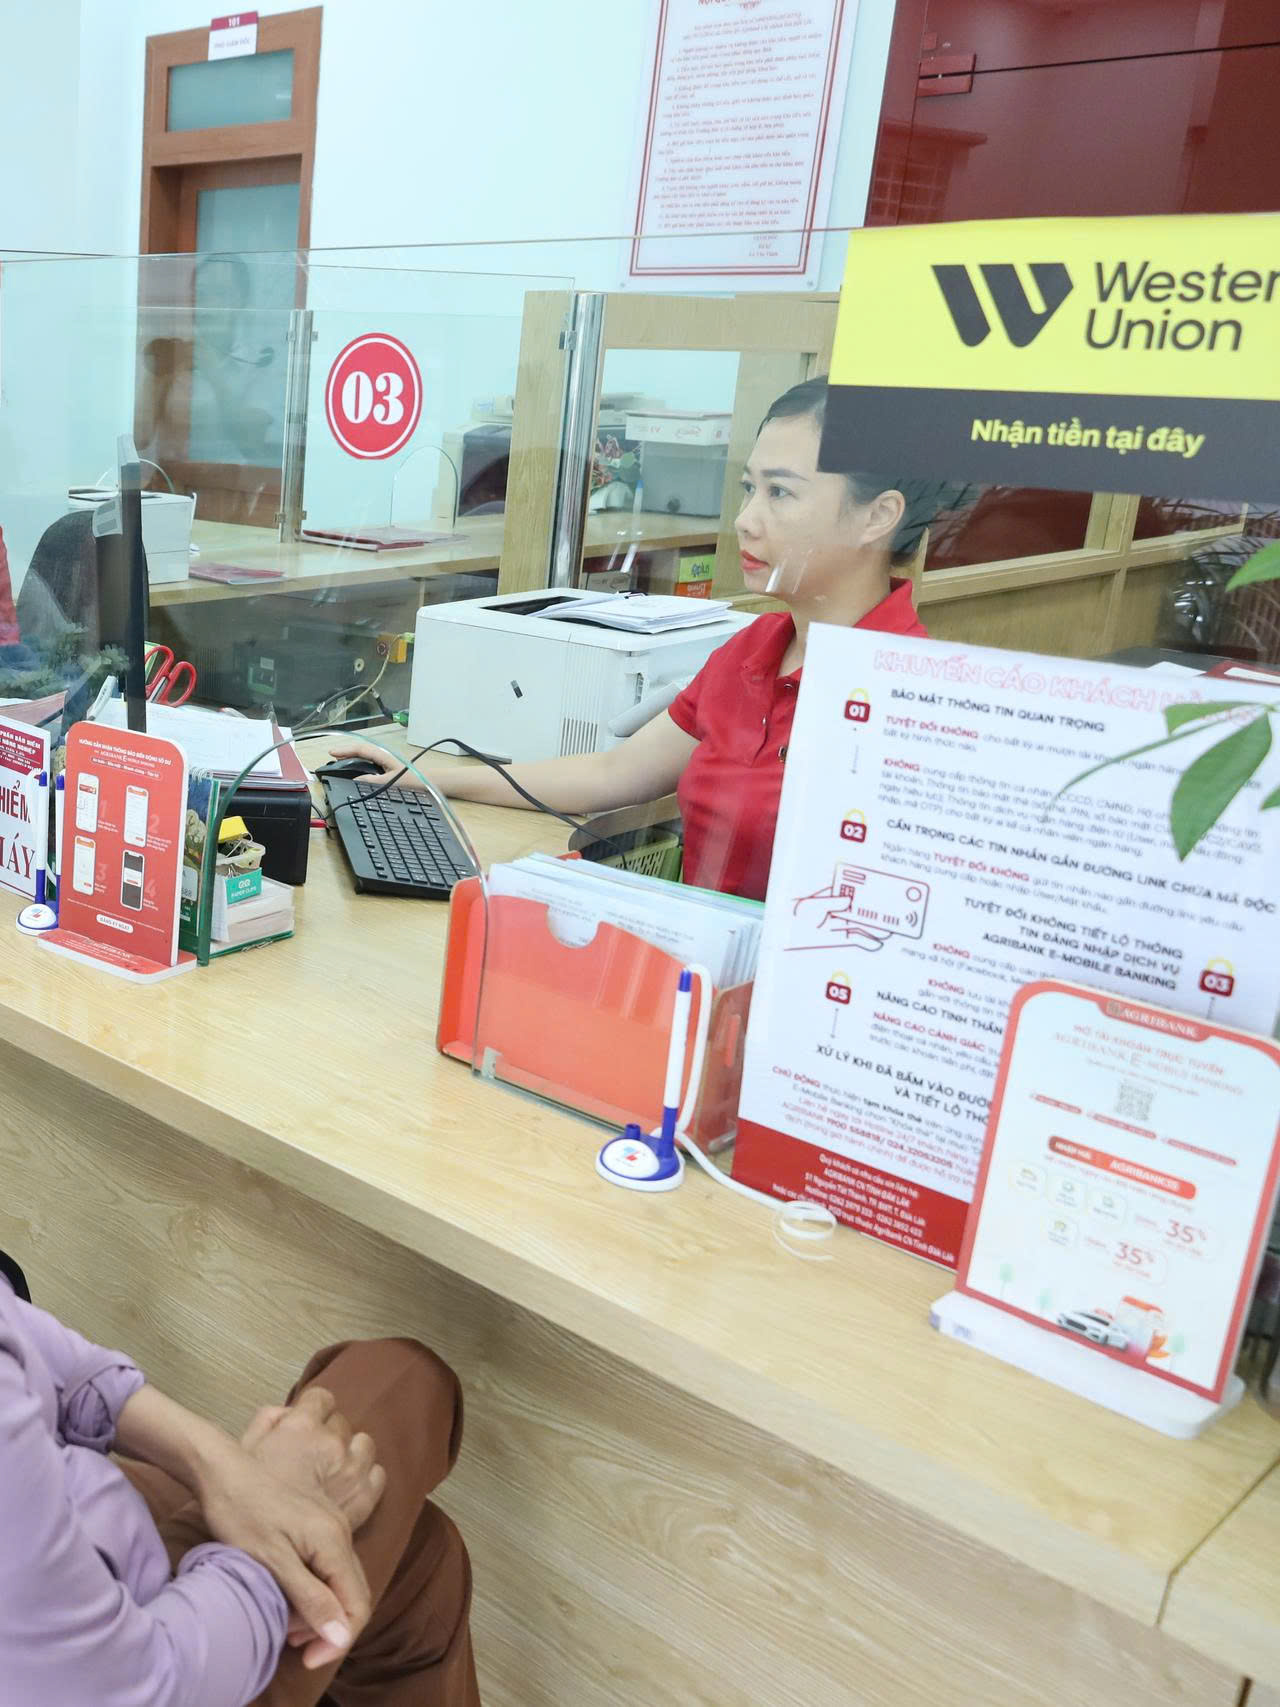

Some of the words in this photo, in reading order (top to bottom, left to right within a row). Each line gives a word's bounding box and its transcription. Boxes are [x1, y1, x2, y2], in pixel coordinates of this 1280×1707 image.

[1095, 260, 1280, 303] Wester
[1085, 307, 1243, 351] Union
[342, 371, 404, 426] 03
[971, 419, 1042, 449] Nhận
[1047, 417, 1100, 447] tiền
[1105, 425, 1144, 455] tại
[1147, 426, 1205, 459] đây
[873, 649, 983, 684] KHUYẾN
[984, 664, 1046, 694] CÁO
[1048, 673, 1158, 713] KHÁCH
[848, 703, 866, 719] 01
[891, 688, 916, 702] BẢO
[948, 697, 990, 714] THÔNG
[994, 706, 1014, 718] TIN
[1017, 709, 1055, 724] QUAN
[1058, 716, 1105, 734] TRỌNG
[843, 823, 864, 839] 02
[915, 825, 955, 843] TRỌNG
[958, 833, 984, 848] CÁC
[989, 841, 1007, 854] TIN
[1083, 861, 1133, 882] ĐƯỜNG
[1137, 874, 1167, 889] LINK
[1171, 881, 1212, 900] CHỨA
[1216, 890, 1239, 905] MÃ
[1243, 897, 1277, 914] ĐỘC
[964, 897, 1002, 915] TUYỆT
[1005, 906, 1028, 921] ĐỐI
[1030, 913, 1077, 934] KHÔNG
[1081, 924, 1107, 940] TIẾT
[1111, 933, 1130, 948] LỘ
[1134, 939, 1183, 960] THÔNG
[982, 931, 1045, 956] AGRIBANK
[1049, 949, 1112, 976] E-MOBILE
[1115, 966, 1177, 991] BANKING
[1019, 925, 1039, 939] TIN
[1123, 952, 1158, 970] DỊCH
[1161, 962, 1181, 976] VỤ
[828, 984, 850, 1000] 05
[876, 990, 909, 1008] NÂNG
[912, 1000, 938, 1016] CAO
[940, 1009, 968, 1025] TINH
[904, 1020, 926, 1034] CAO
[1121, 1007, 1198, 1038] AGRIBANK
[852, 1057, 873, 1071] KHI
[876, 1063, 893, 1078] ĐÃ
[896, 1069, 923, 1087] BẤM
[927, 1080, 954, 1097] VÀO
[894, 1085, 912, 1100] VÀ
[914, 1092, 940, 1109] TIẾT
[942, 1101, 961, 1117] LỘ
